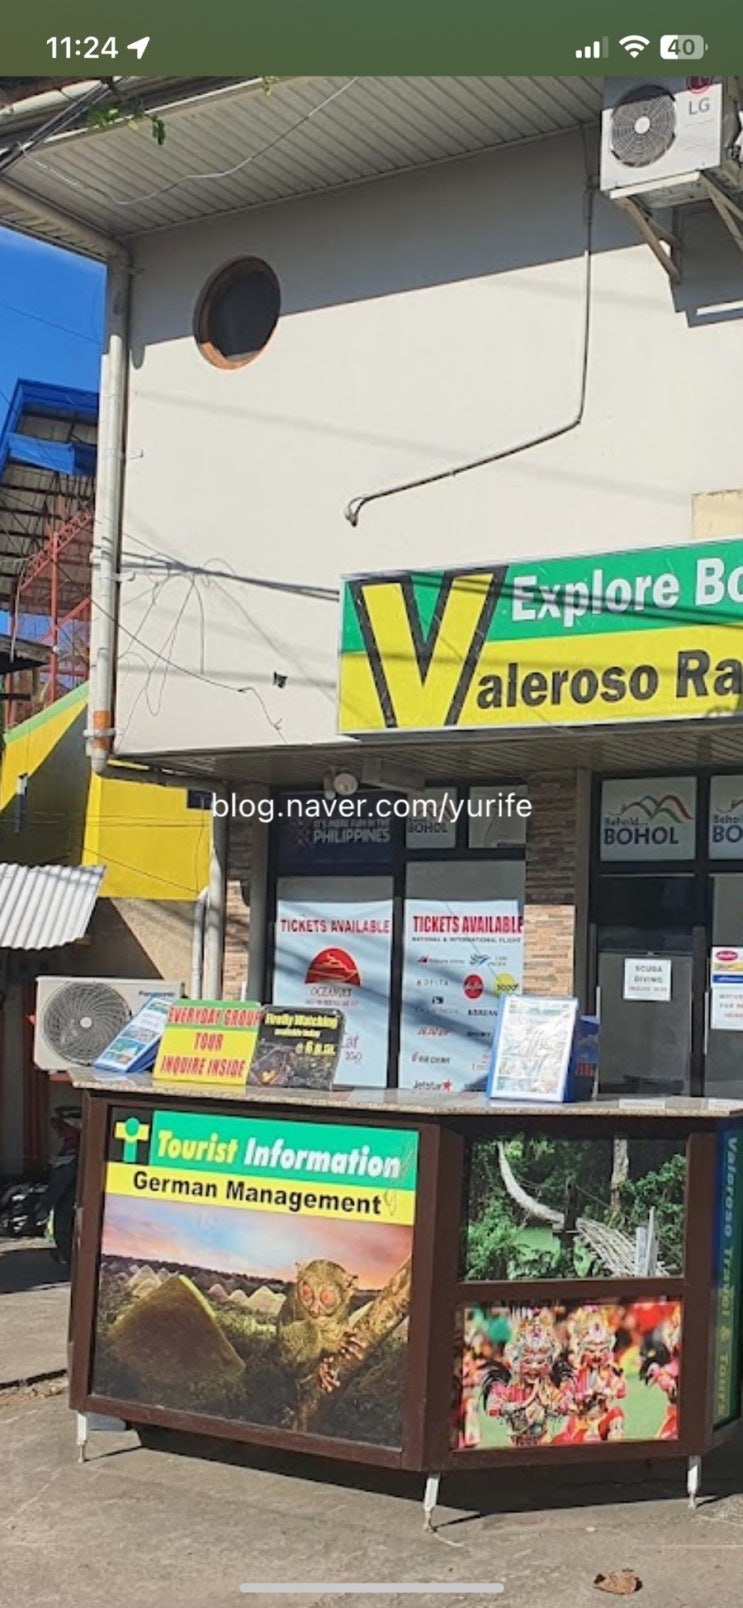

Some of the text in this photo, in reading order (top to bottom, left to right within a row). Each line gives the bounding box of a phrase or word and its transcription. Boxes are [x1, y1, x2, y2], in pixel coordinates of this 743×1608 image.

[688, 97, 711, 115] LG
[511, 569, 680, 628] Explore
[676, 649, 743, 698] Ra
[313, 828, 391, 844] PHILIPPINES
[603, 827, 680, 845] BOHOL
[712, 825, 743, 843] BO
[281, 919, 390, 934] TICKETS AVAILABLE
[412, 915, 523, 934] TICKETS AVAILABLE
[635, 965, 663, 973] SCUBA
[167, 1007, 222, 1024] EVERYDAY
[224, 1008, 263, 1026] GROUP
[264, 1012, 339, 1029] Firefly Watching
[194, 1032, 224, 1050] TOUR
[305, 1040, 314, 1055] 6
[161, 1055, 246, 1077] INQUIRE INSIDE
[157, 1129, 402, 1179] Tourist Information
[133, 1170, 383, 1215] German Management
